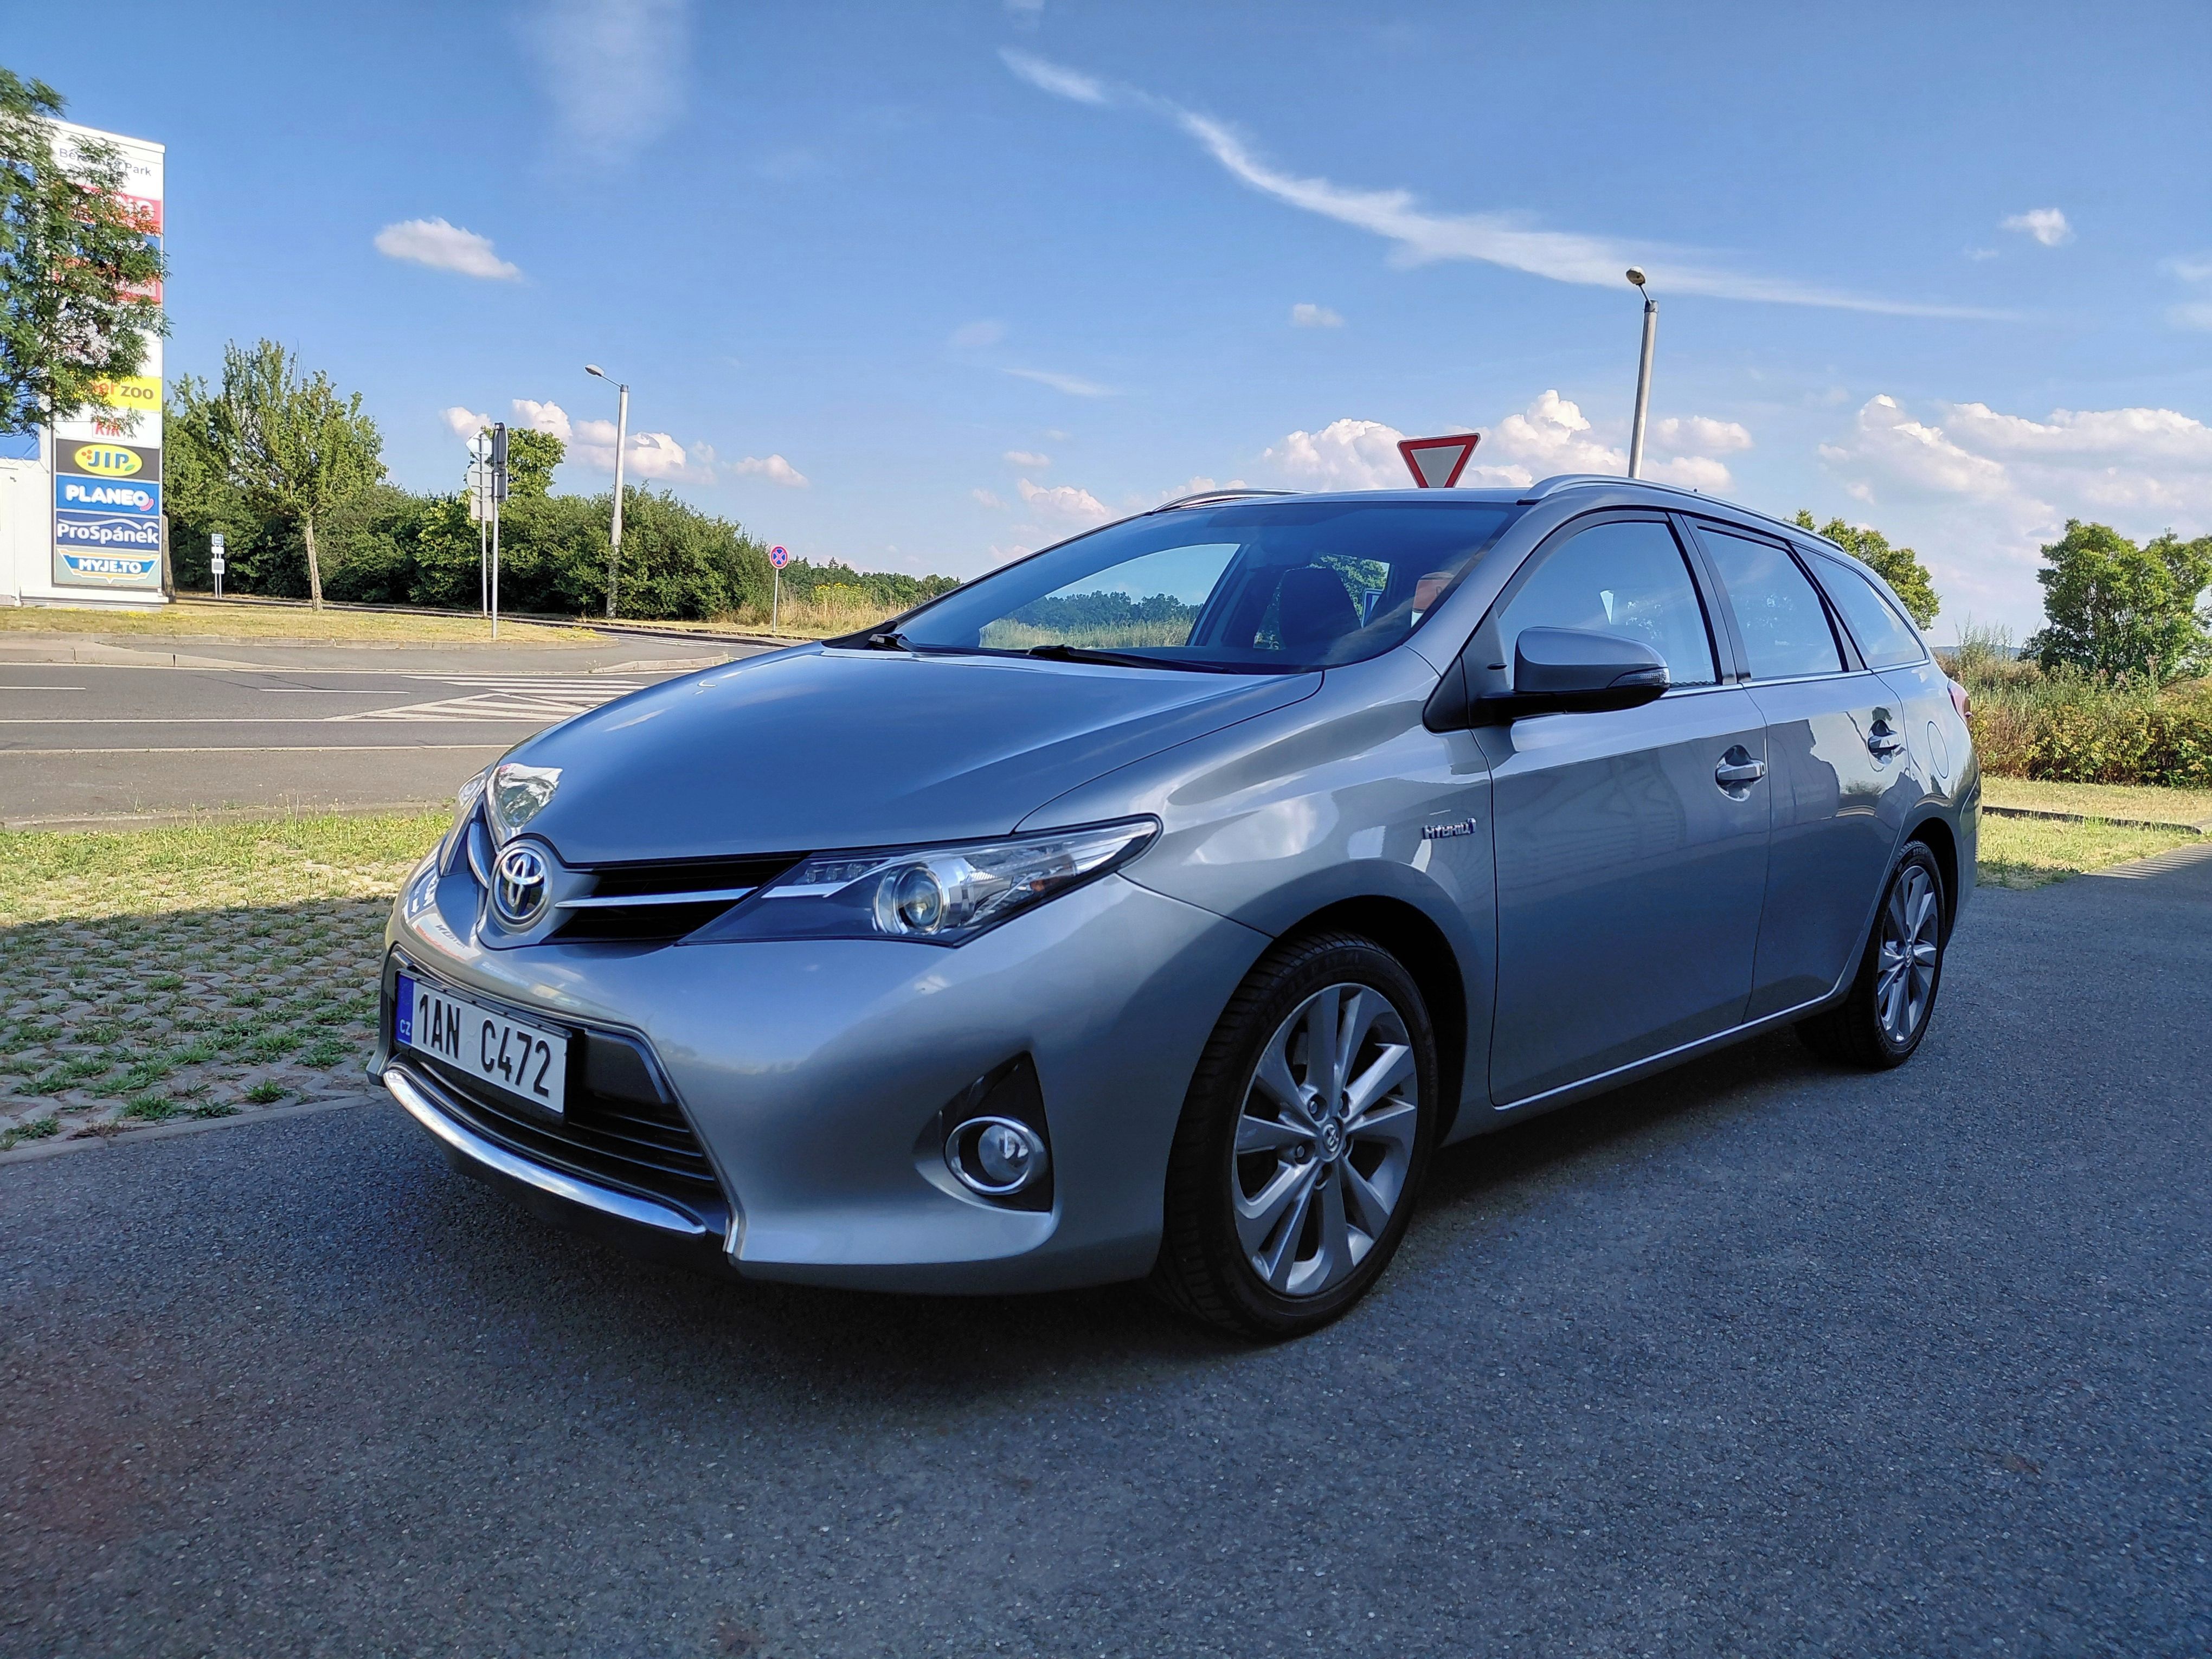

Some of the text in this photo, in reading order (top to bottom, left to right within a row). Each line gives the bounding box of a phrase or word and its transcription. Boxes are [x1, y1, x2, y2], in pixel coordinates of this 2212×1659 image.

[125, 163, 152, 176] Park
[87, 451, 130, 469] JIP
[66, 484, 150, 507] PLANEO
[57, 523, 159, 544] ProSpánek
[79, 559, 142, 574] MYJE.TO
[1423, 821, 1471, 839] HYBRID
[400, 993, 550, 1098] CZ 1AN C472
